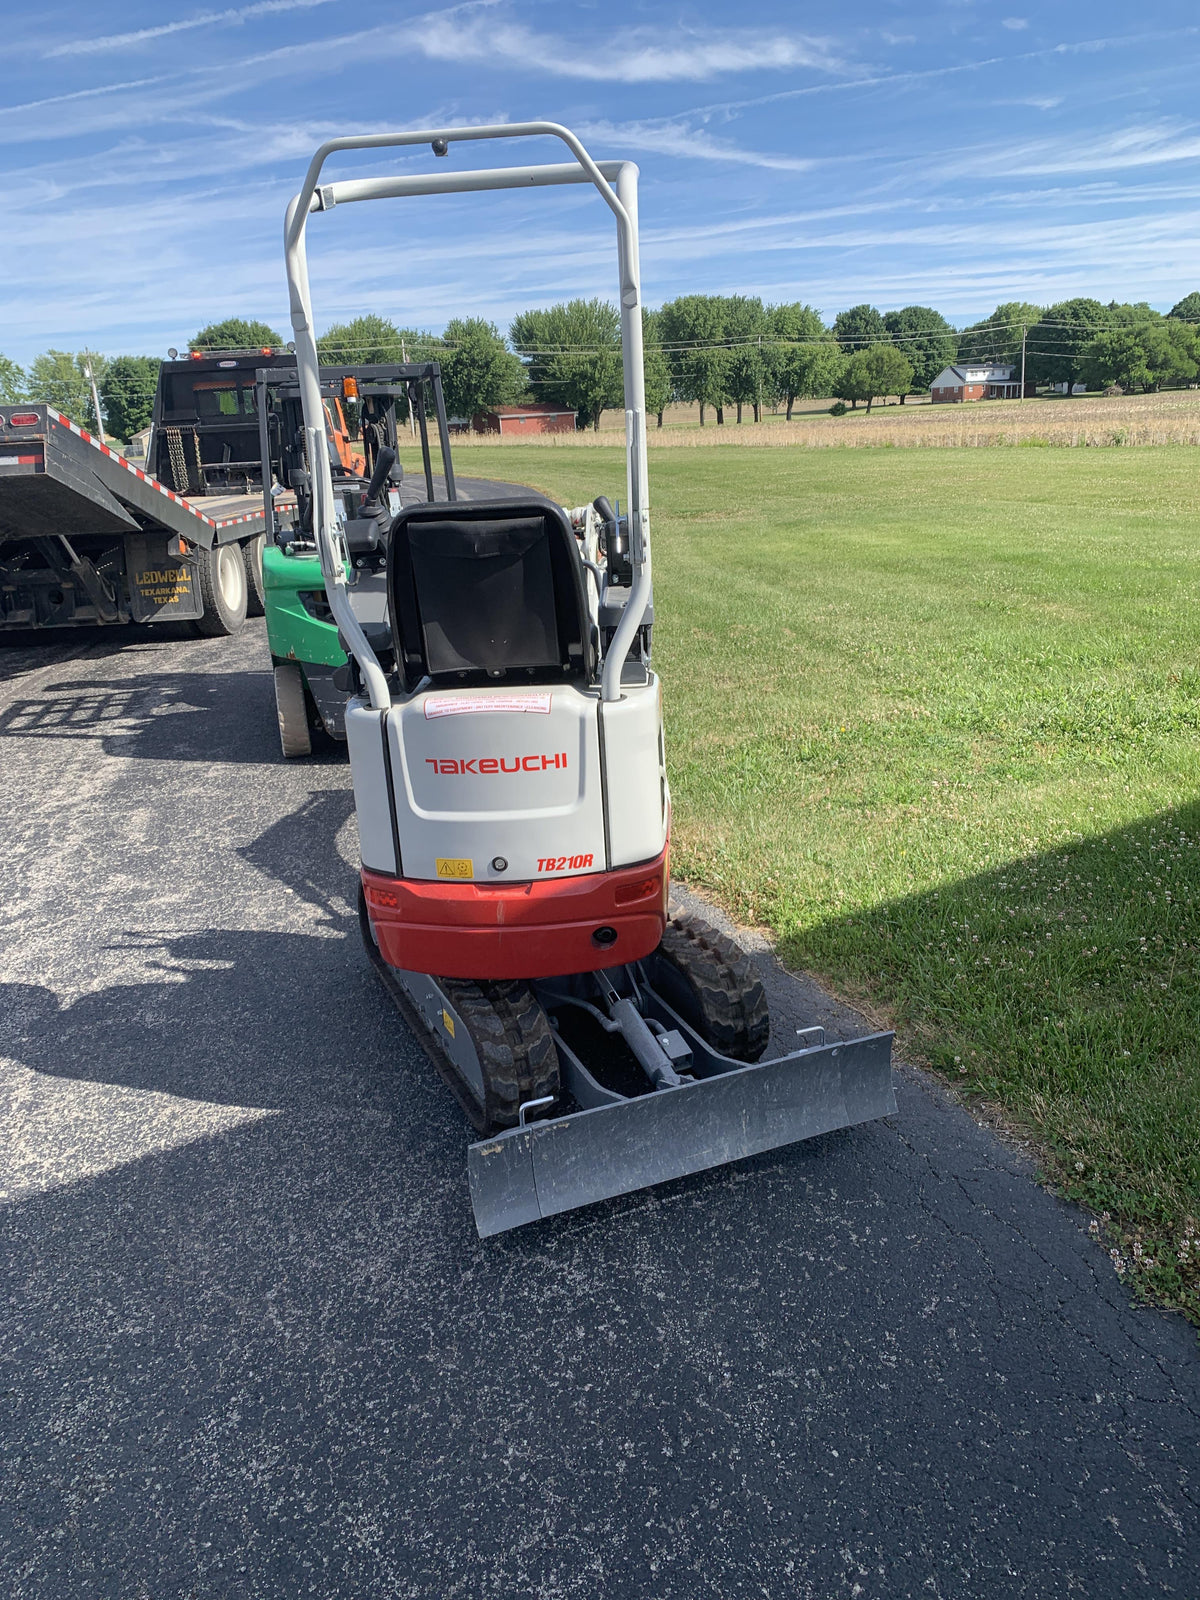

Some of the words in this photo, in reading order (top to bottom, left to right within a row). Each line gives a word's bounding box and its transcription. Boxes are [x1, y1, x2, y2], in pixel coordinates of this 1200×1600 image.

[135, 568, 191, 585] LEDWELL
[153, 595, 179, 604] TEXAS
[425, 752, 567, 775] TAKEUCHI
[537, 853, 594, 873] TB210R
